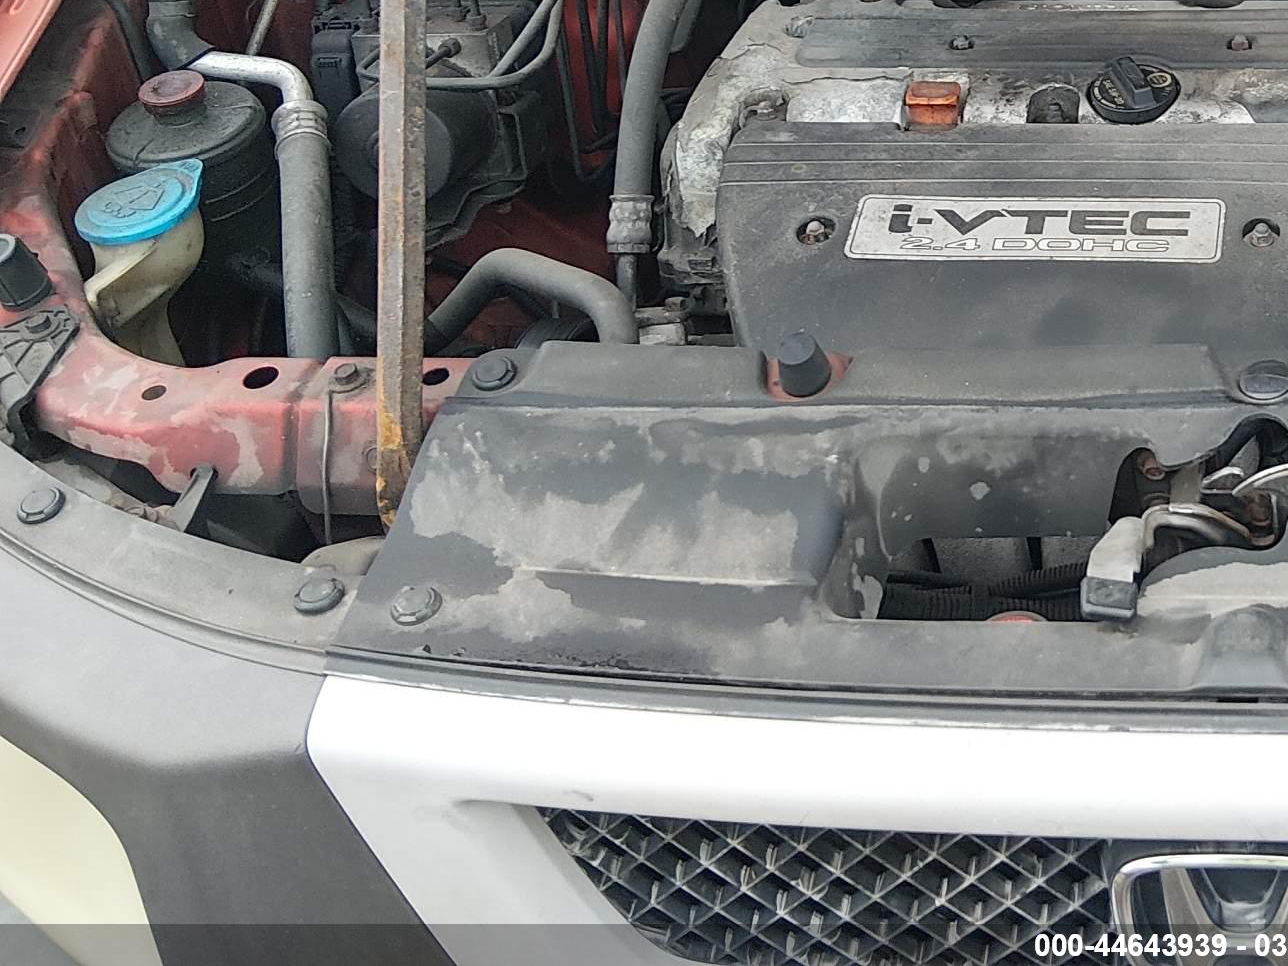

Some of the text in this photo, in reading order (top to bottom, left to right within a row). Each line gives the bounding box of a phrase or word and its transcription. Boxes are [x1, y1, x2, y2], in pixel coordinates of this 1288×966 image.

[888, 203, 1192, 237] i-VTEC
[899, 236, 1170, 253] 2.4 DOHC
